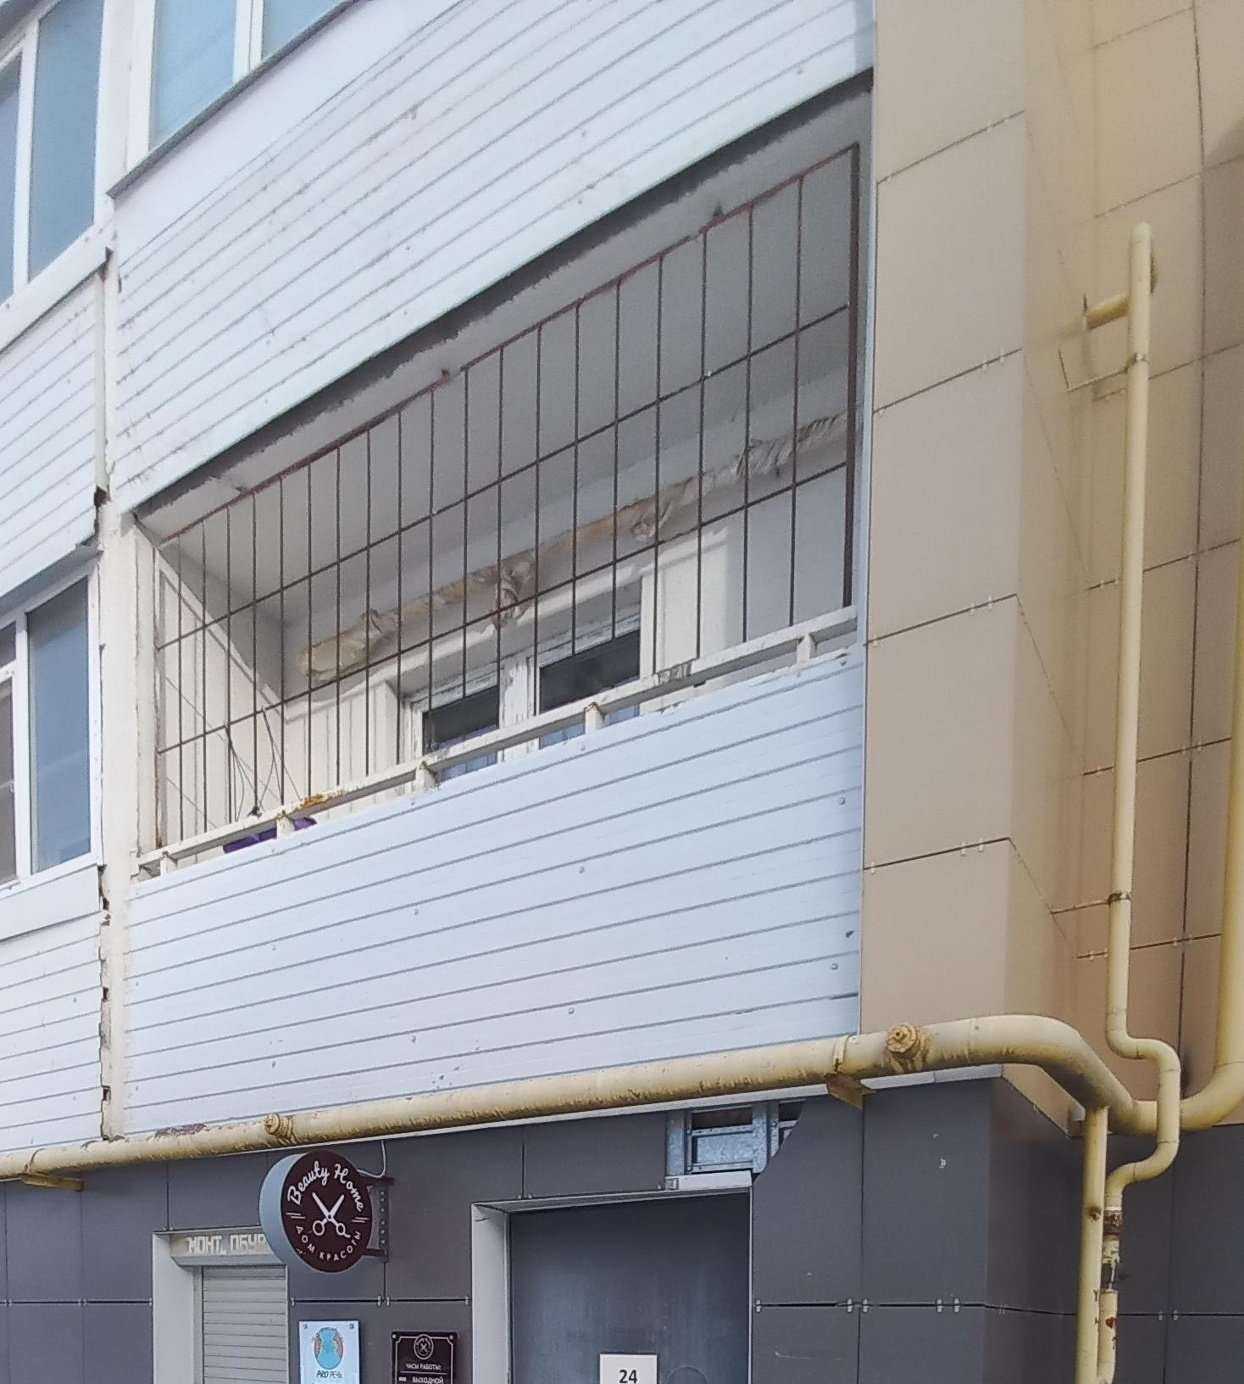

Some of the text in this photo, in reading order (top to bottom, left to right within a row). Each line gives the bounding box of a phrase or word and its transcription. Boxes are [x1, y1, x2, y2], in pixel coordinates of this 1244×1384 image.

[287, 1161, 365, 1212] Beauty Home
[295, 1225, 361, 1261] ДОМ КРАСОТЫ
[619, 1369, 638, 1384] 24
